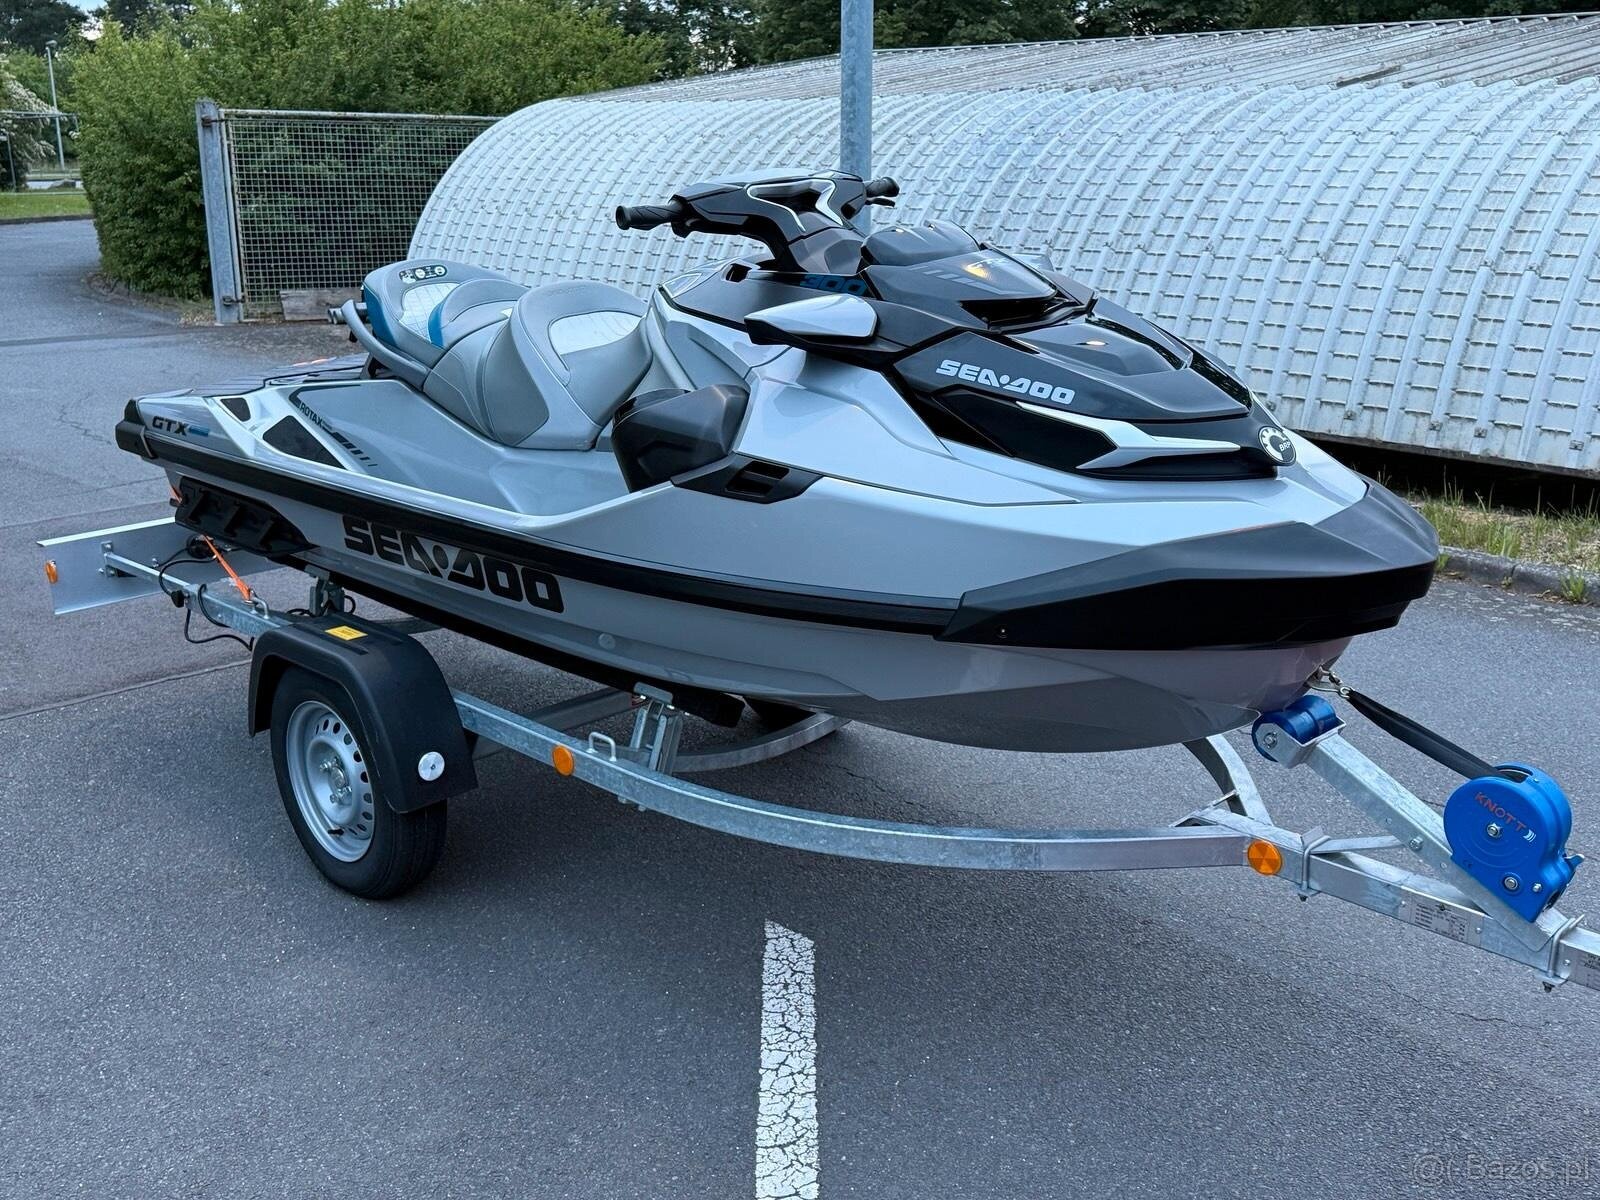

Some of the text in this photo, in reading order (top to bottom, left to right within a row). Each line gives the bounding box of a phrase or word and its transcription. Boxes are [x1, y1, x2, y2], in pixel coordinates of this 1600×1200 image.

[800, 274, 867, 296] 300
[299, 402, 323, 428] ROTAX
[152, 416, 190, 437] GTX
[1278, 440, 1292, 452] BRP
[1475, 791, 1527, 832] KNOTT
